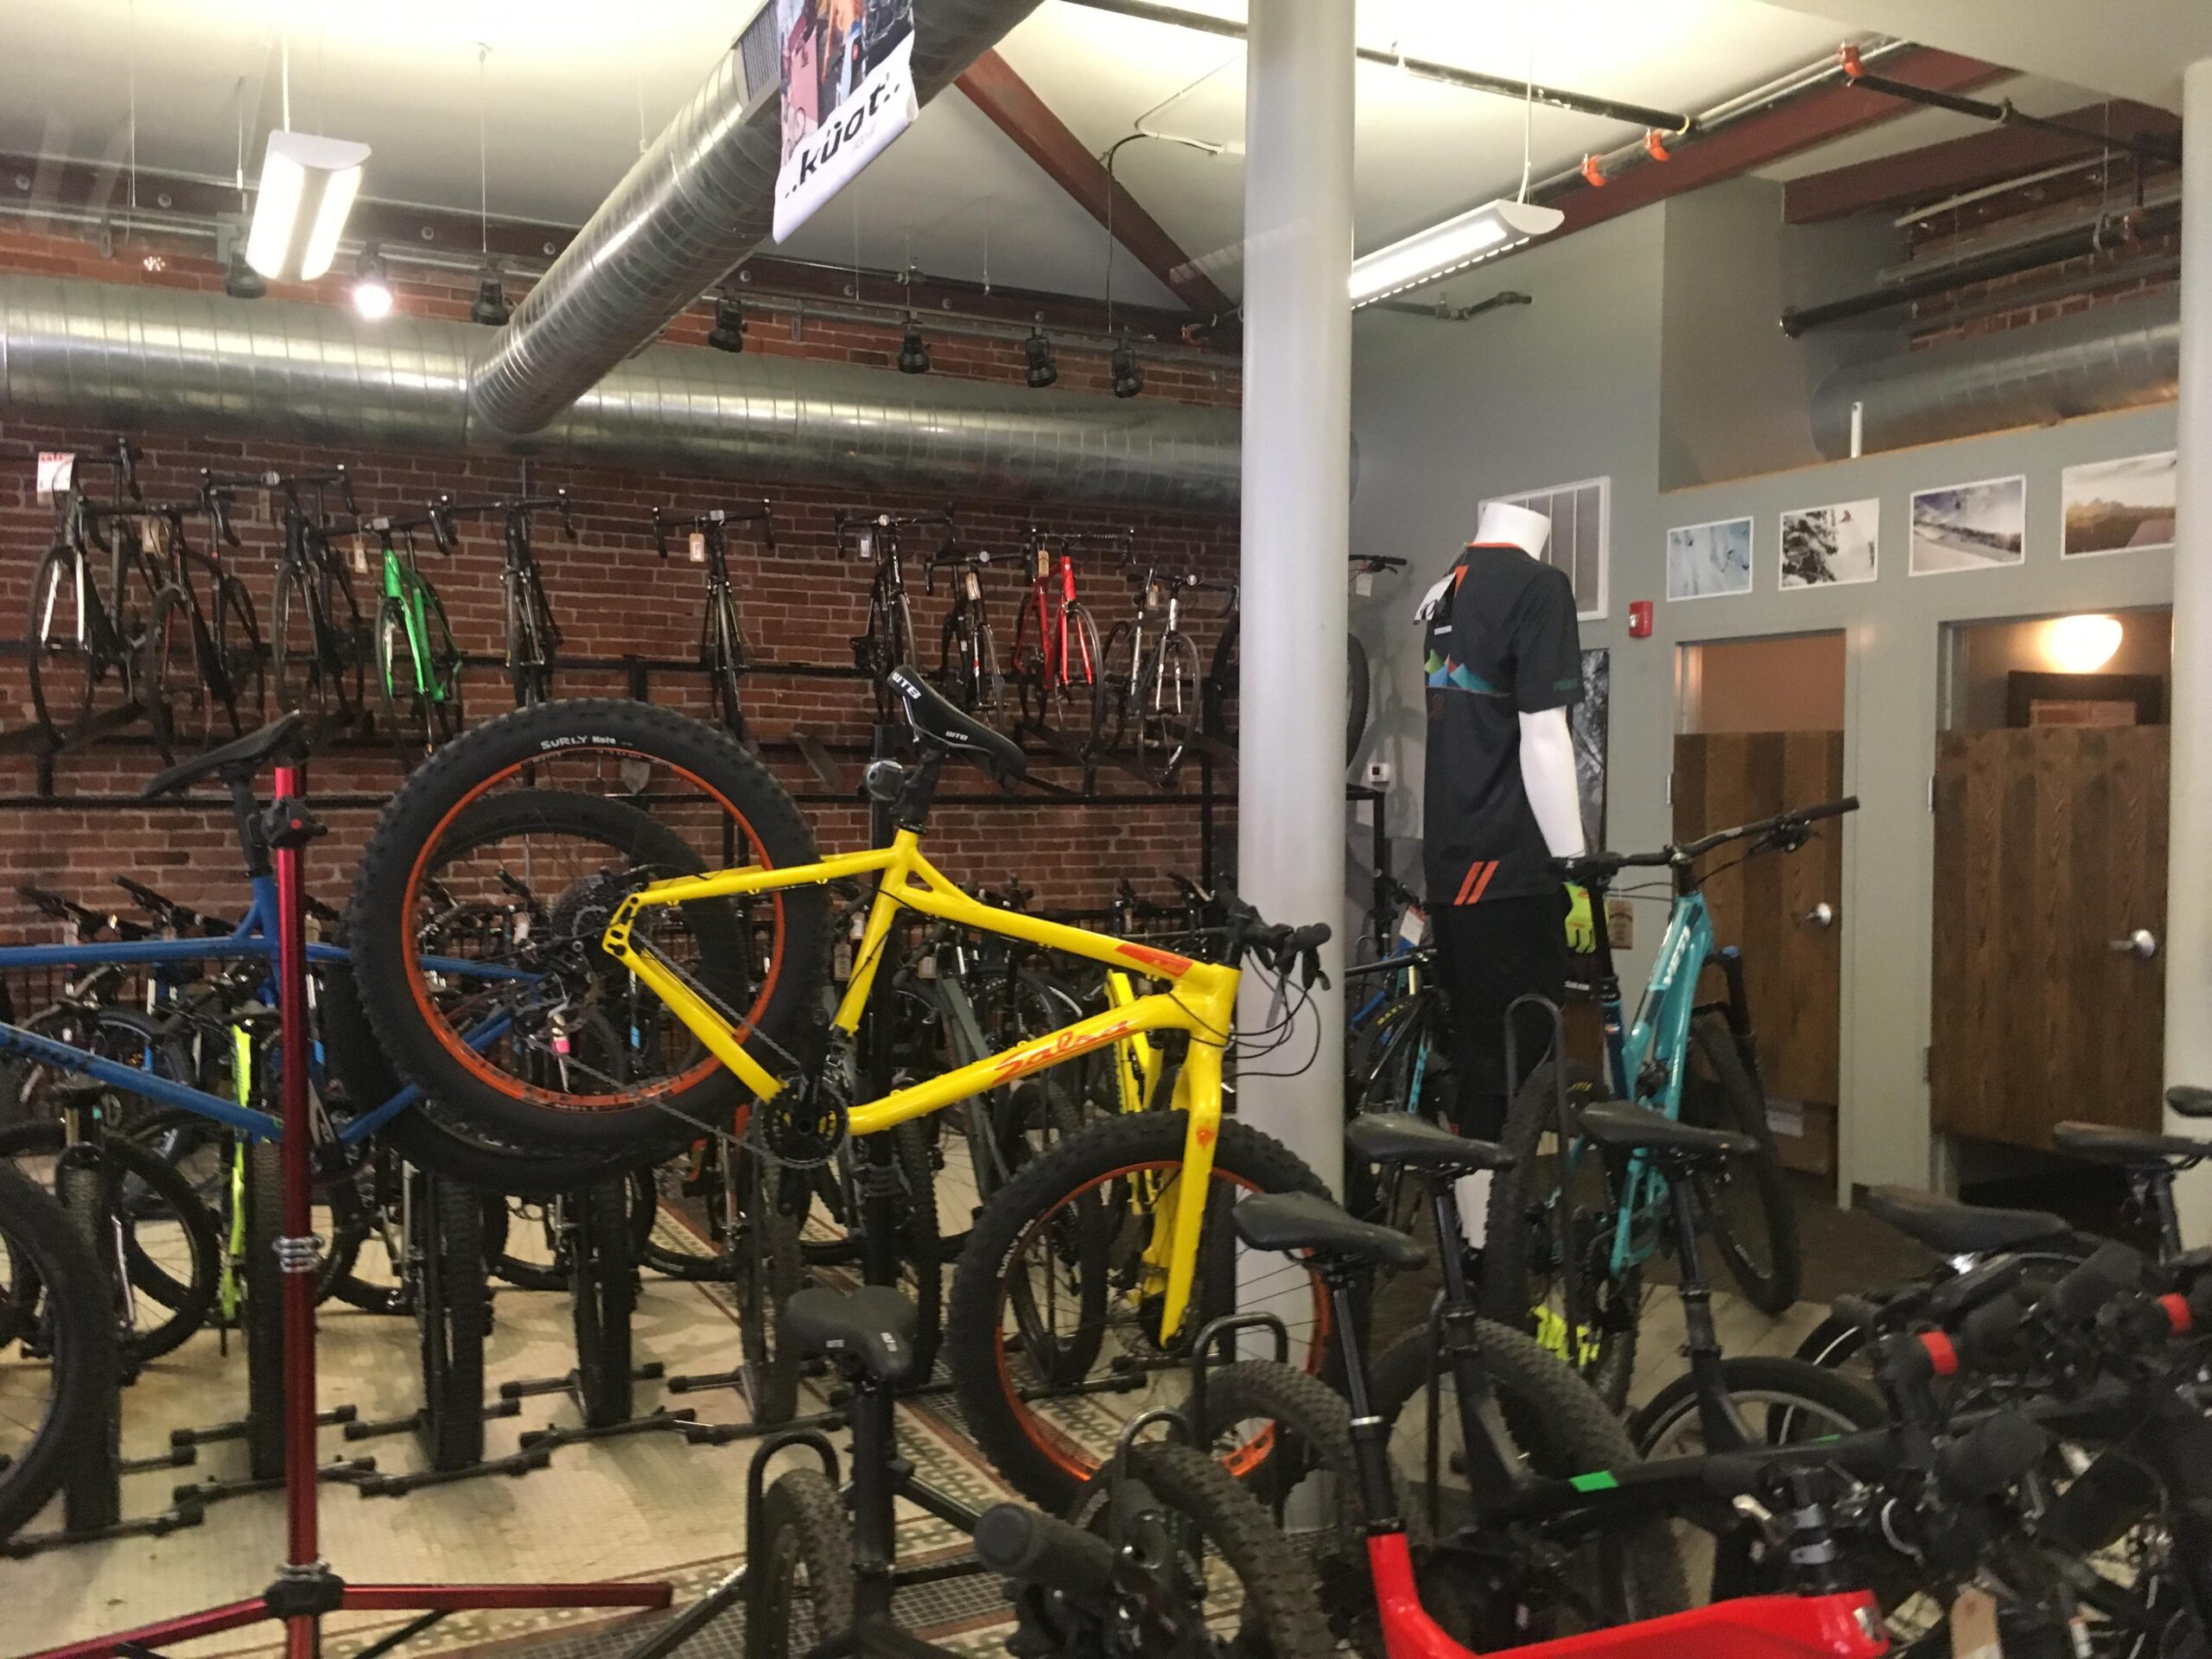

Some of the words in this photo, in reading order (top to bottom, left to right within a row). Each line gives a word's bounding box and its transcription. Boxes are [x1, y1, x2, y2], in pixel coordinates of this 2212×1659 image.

[892, 671, 922, 700] WTB
[540, 735, 588, 750] SURLY
[945, 730, 969, 741] WTB
